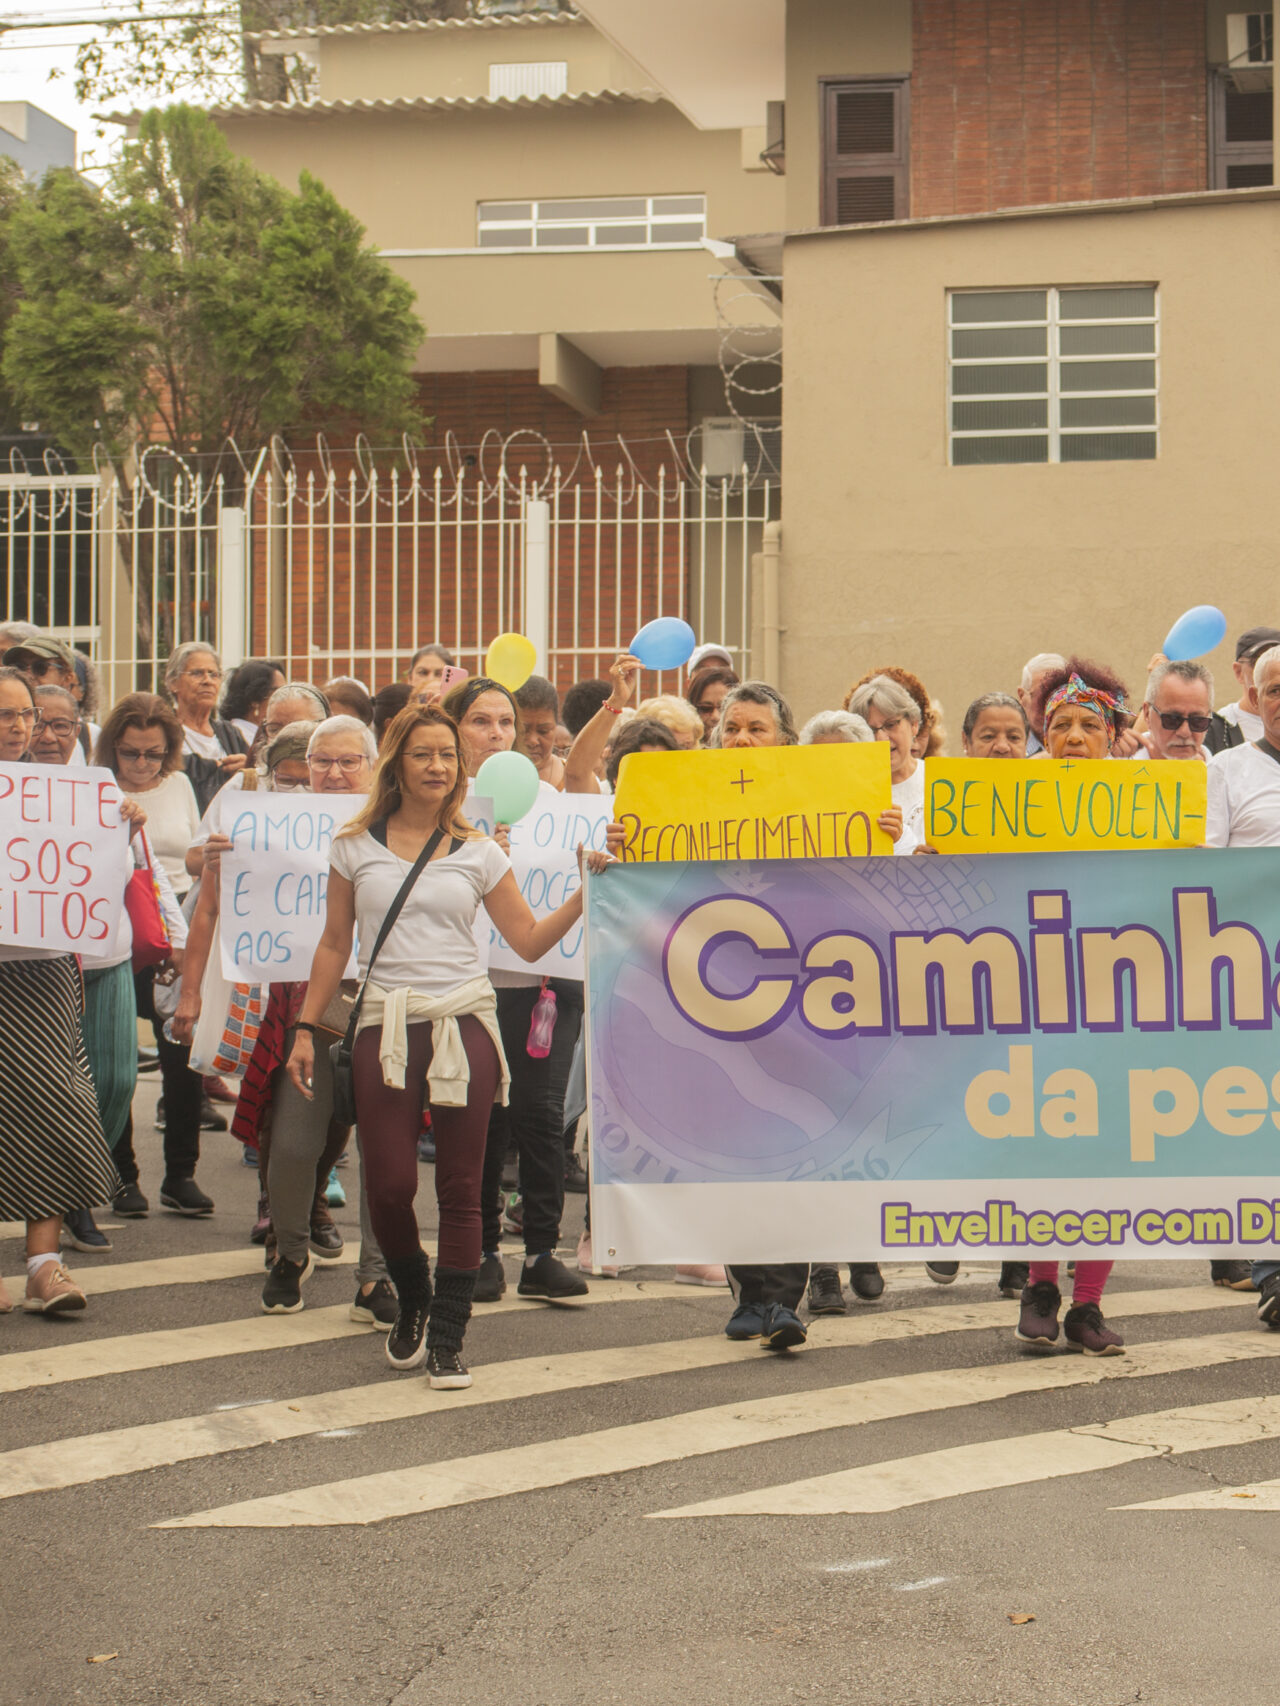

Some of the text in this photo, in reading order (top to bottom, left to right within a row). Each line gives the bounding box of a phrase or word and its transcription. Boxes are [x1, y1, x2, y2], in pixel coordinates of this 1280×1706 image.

[230, 811, 334, 851] AMOR
[0, 889, 110, 940] ITOS
[234, 871, 251, 917] E
[234, 930, 294, 966] AOS
[964, 1045, 1100, 1140] da
[881, 1200, 1131, 1247] Envelhecer
[1134, 1208, 1234, 1245] com
